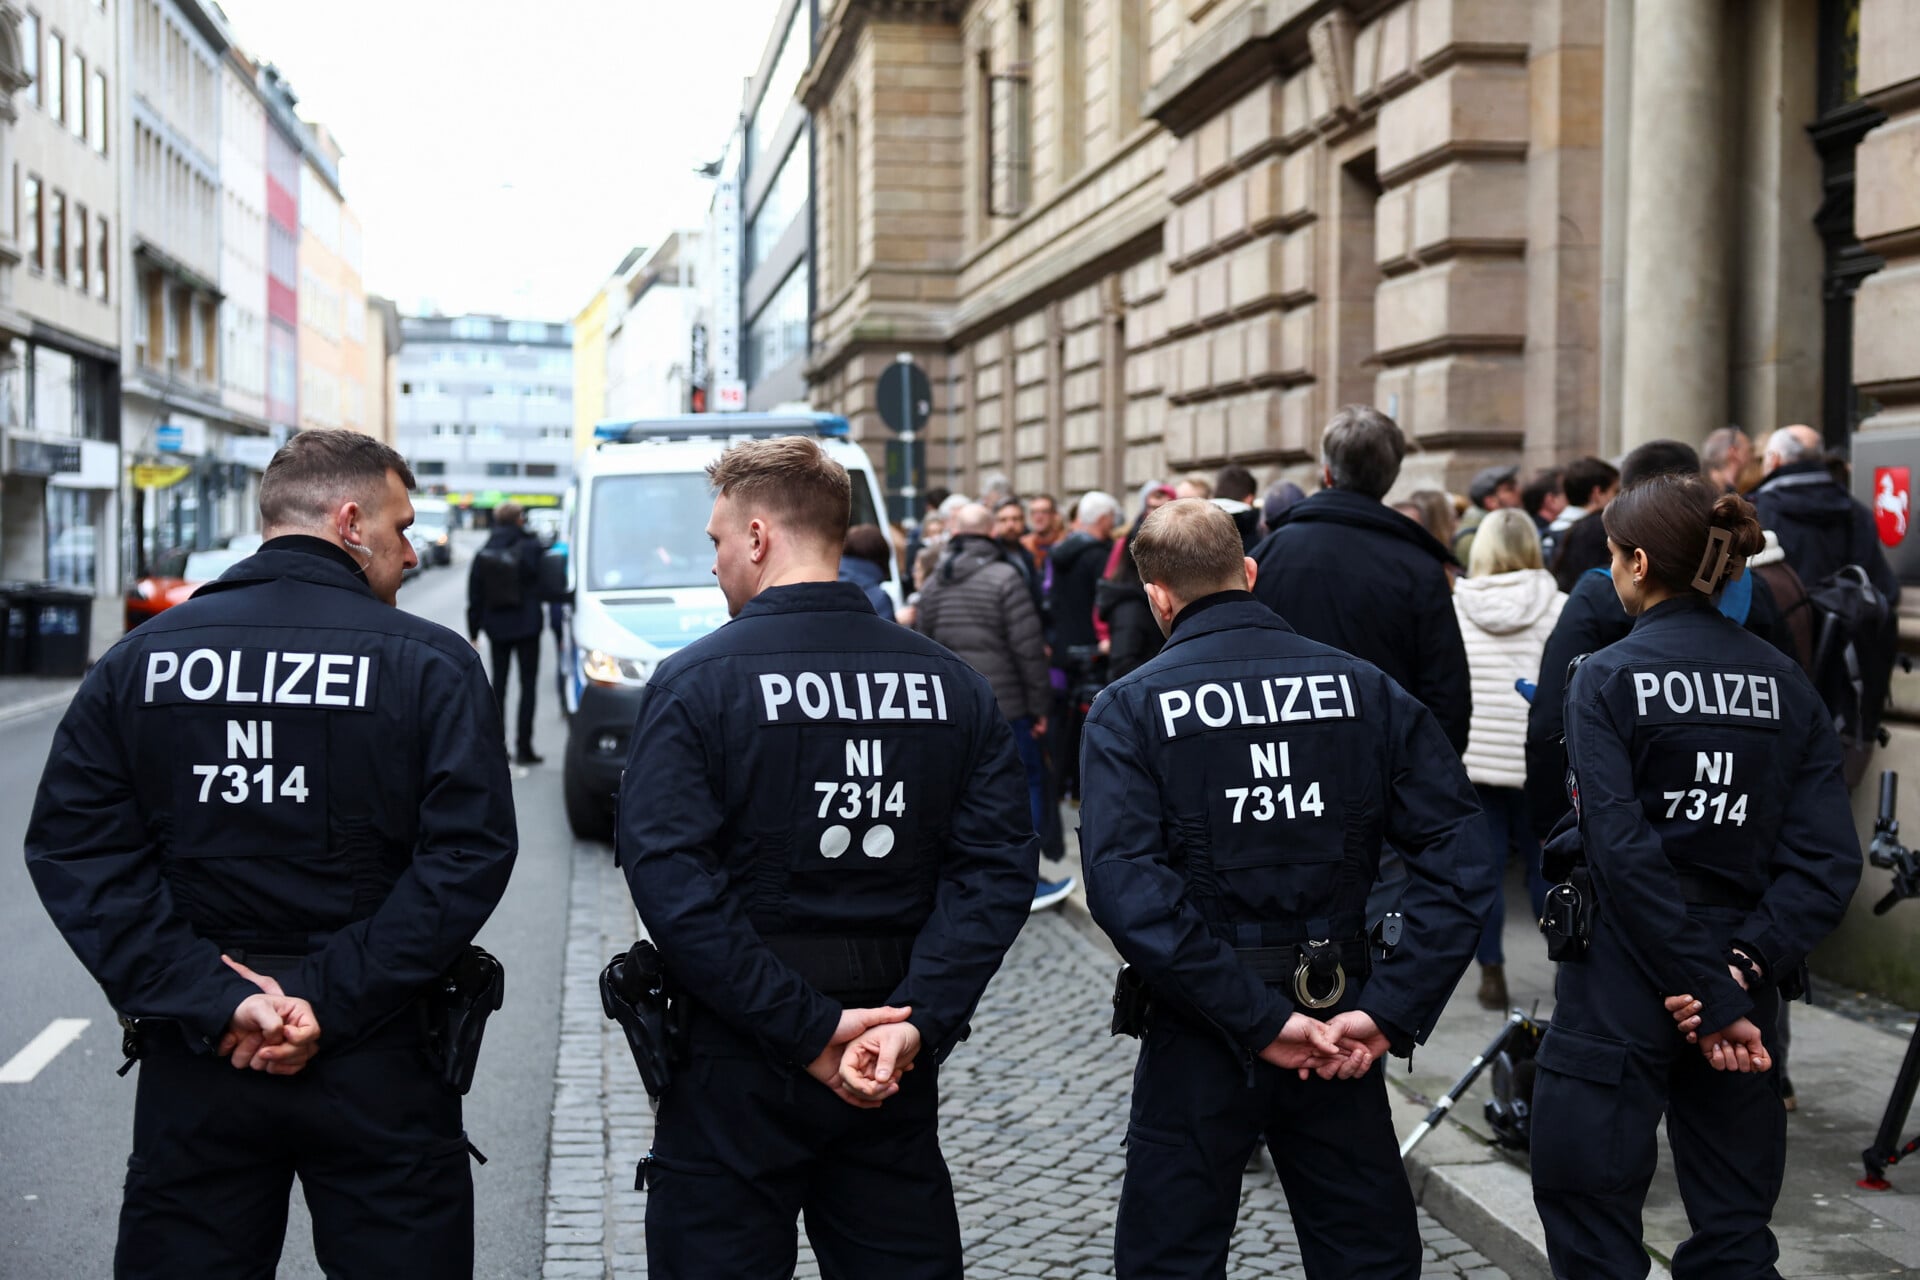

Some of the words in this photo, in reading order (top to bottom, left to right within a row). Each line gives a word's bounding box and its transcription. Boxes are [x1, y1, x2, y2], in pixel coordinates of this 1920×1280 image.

[145, 649, 370, 706] POLIZEI
[759, 671, 947, 721] POLIZEI
[1632, 671, 1780, 719] POLIZEI
[1159, 675, 1355, 737] POLIZEI
[228, 720, 272, 758] NI
[846, 740, 882, 776] NI
[1250, 742, 1290, 778] NI
[1694, 752, 1733, 785] NI
[193, 765, 308, 803] 7314
[815, 782, 905, 820] 7314
[1225, 782, 1324, 823] 7314
[1664, 789, 1747, 826] 7314
